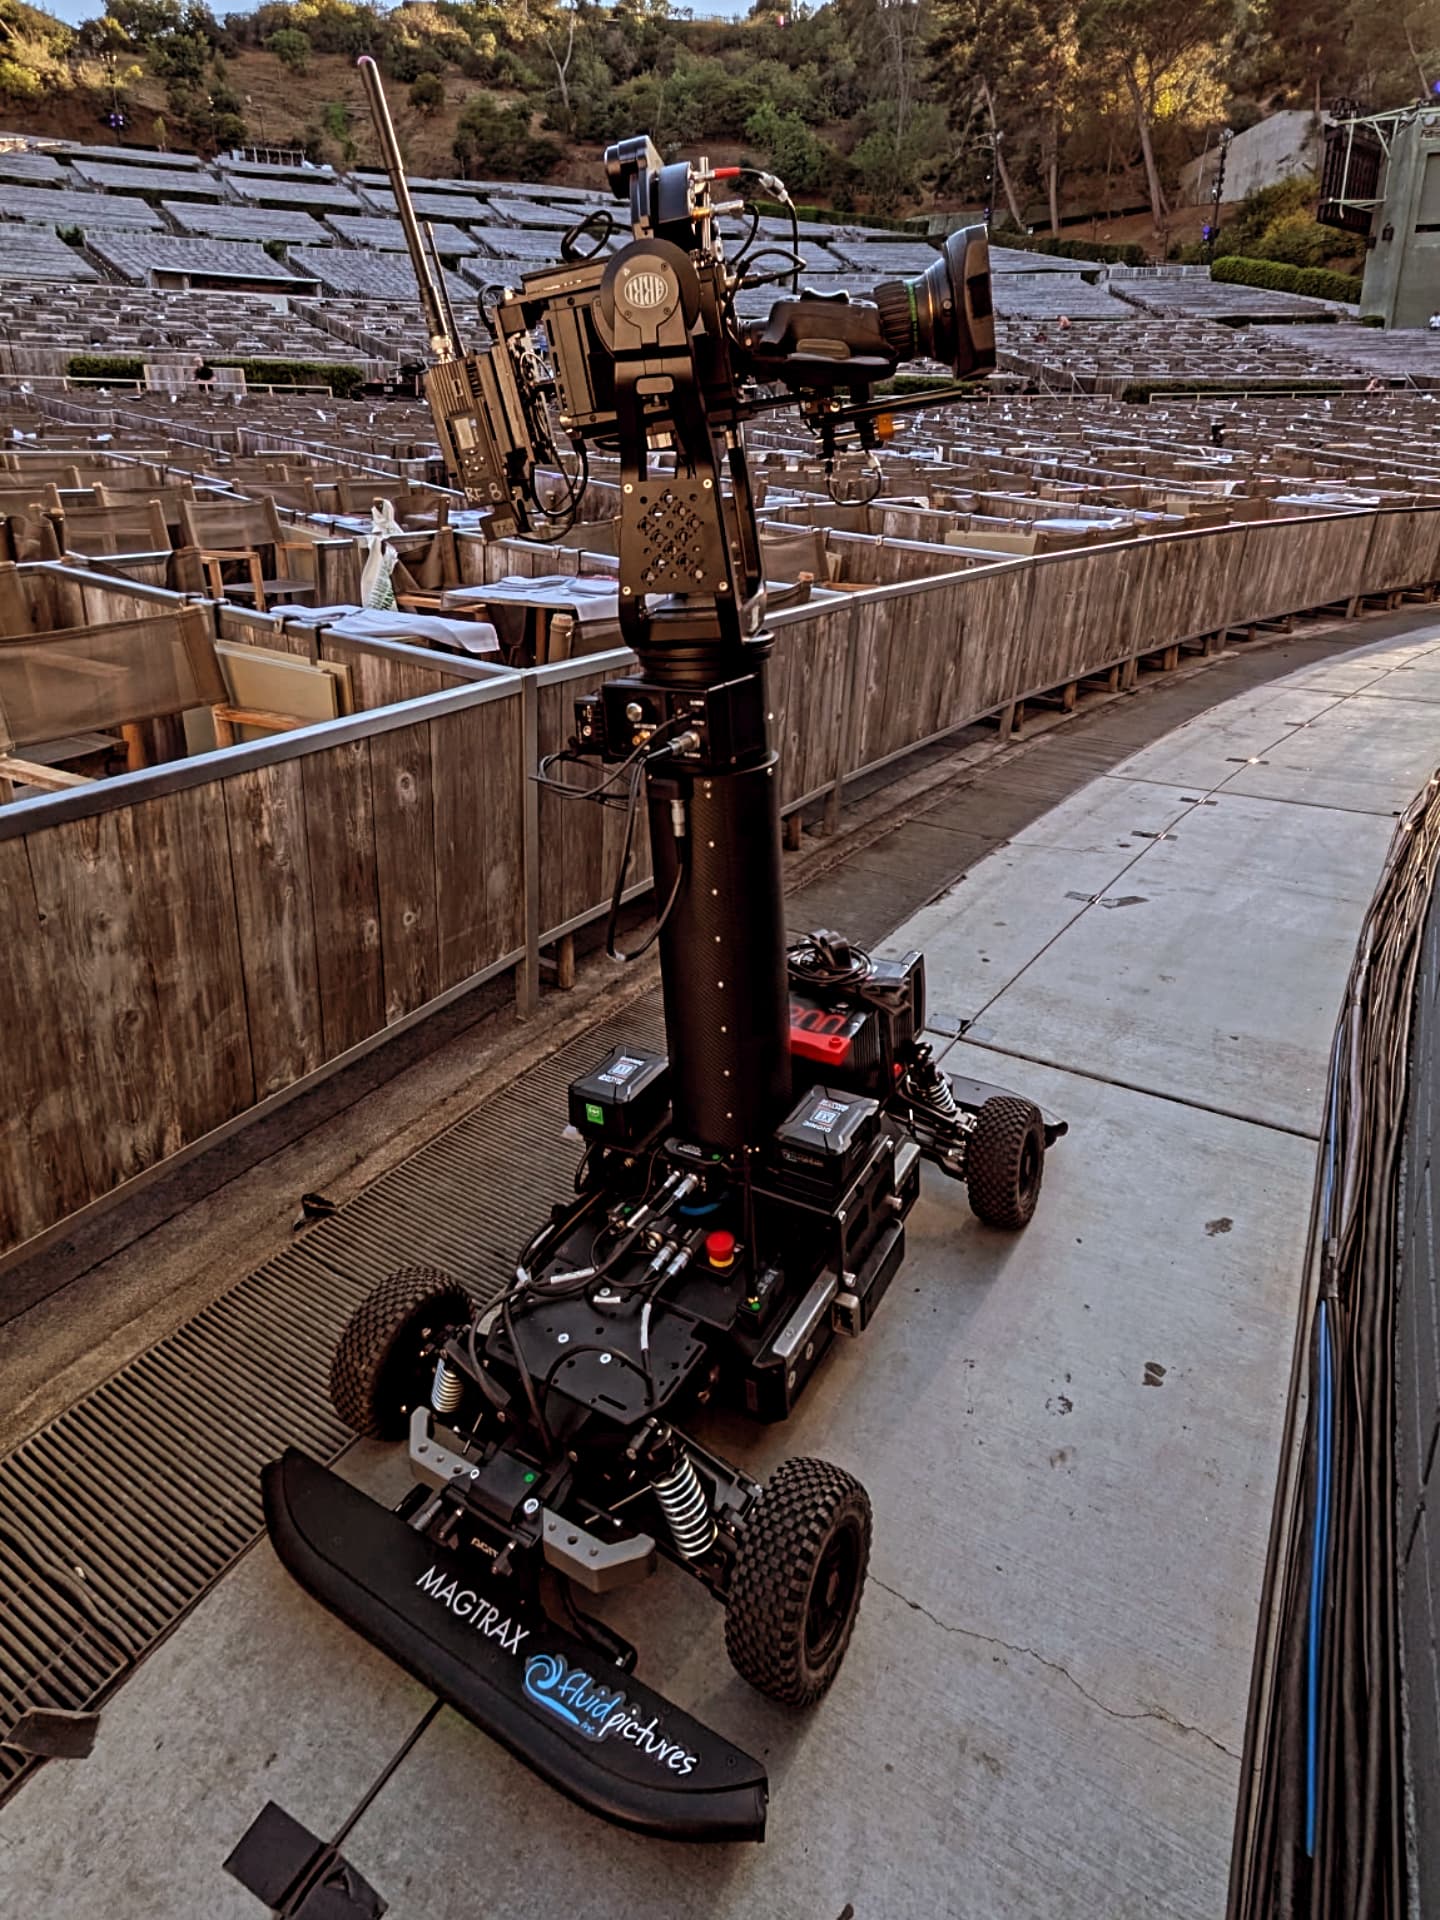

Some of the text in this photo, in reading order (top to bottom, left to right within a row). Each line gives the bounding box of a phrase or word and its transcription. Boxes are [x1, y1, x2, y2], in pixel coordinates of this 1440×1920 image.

[626, 274, 665, 306] ARRI
[489, 482, 502, 501] 8
[416, 1564, 530, 1655] MAGTRAX
